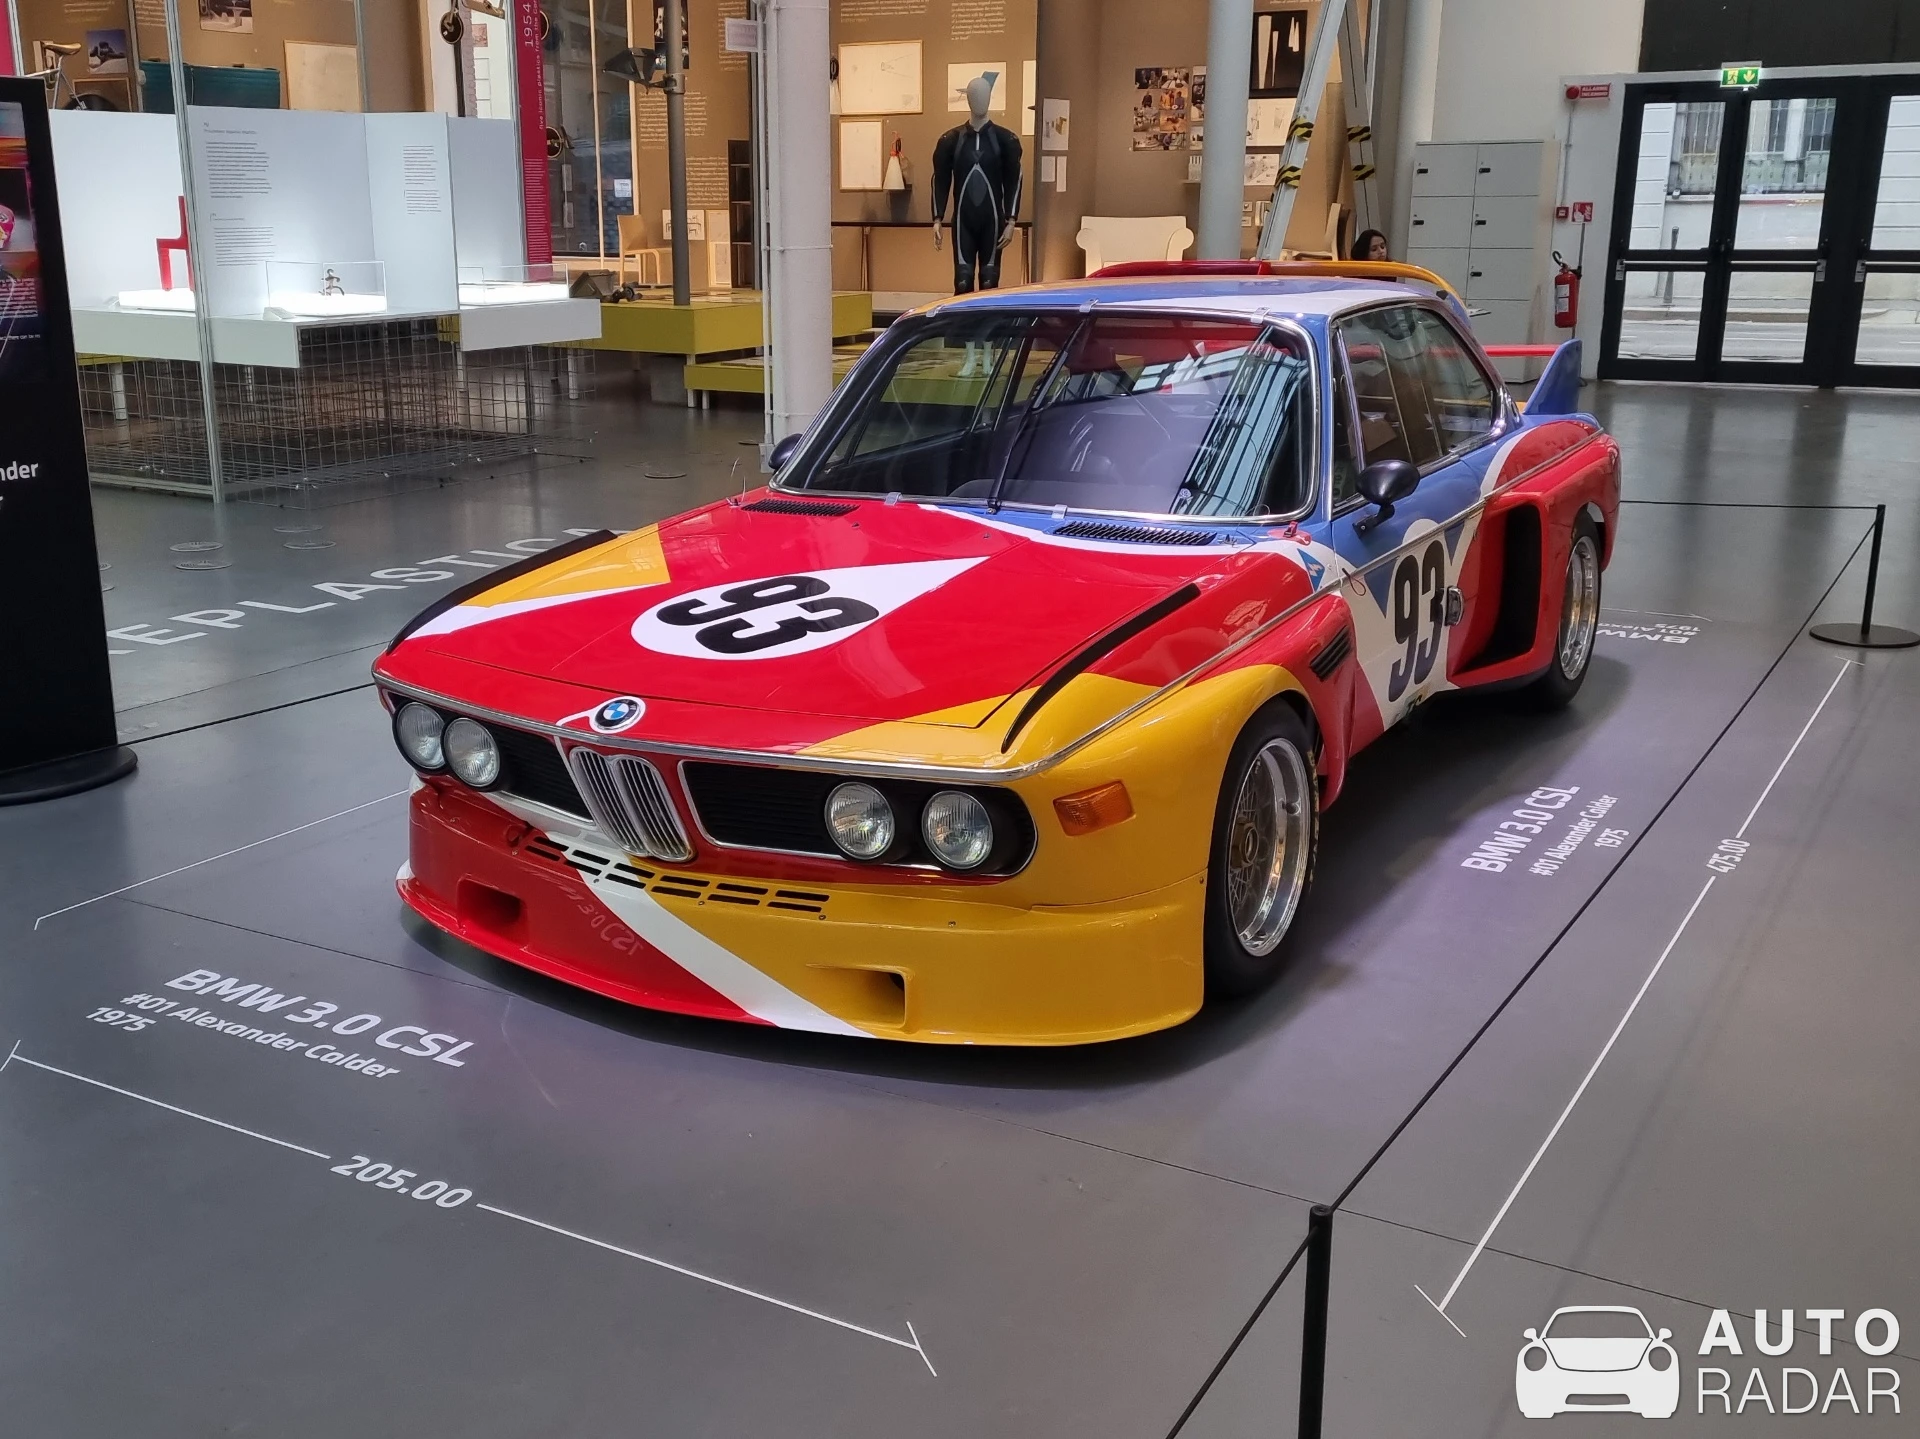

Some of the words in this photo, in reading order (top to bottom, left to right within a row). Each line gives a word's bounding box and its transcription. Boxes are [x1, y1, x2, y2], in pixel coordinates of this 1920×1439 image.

[523, 3, 533, 47] 1954
[656, 575, 880, 654] 93
[1389, 540, 1445, 702] 93
[1595, 629, 1690, 644] BMW
[1524, 786, 1581, 809] CSL
[1579, 794, 1619, 819] Calder
[1500, 808, 1555, 834] 3.0
[1544, 818, 1598, 861] Alexander
[1594, 828, 1630, 848] 1975
[1460, 830, 1533, 873] BMW
[1528, 858, 1564, 877] #01
[1705, 838, 1752, 875] 475.00
[86, 1007, 157, 1032] 1975
[119, 993, 180, 1014] #01
[165, 1007, 309, 1052] Alexander
[304, 1044, 401, 1078] Calder
[164, 969, 307, 1013] BMW
[284, 1002, 382, 1035] 3.0
[375, 1026, 475, 1068] CSL
[330, 1155, 474, 1209] 205.00
